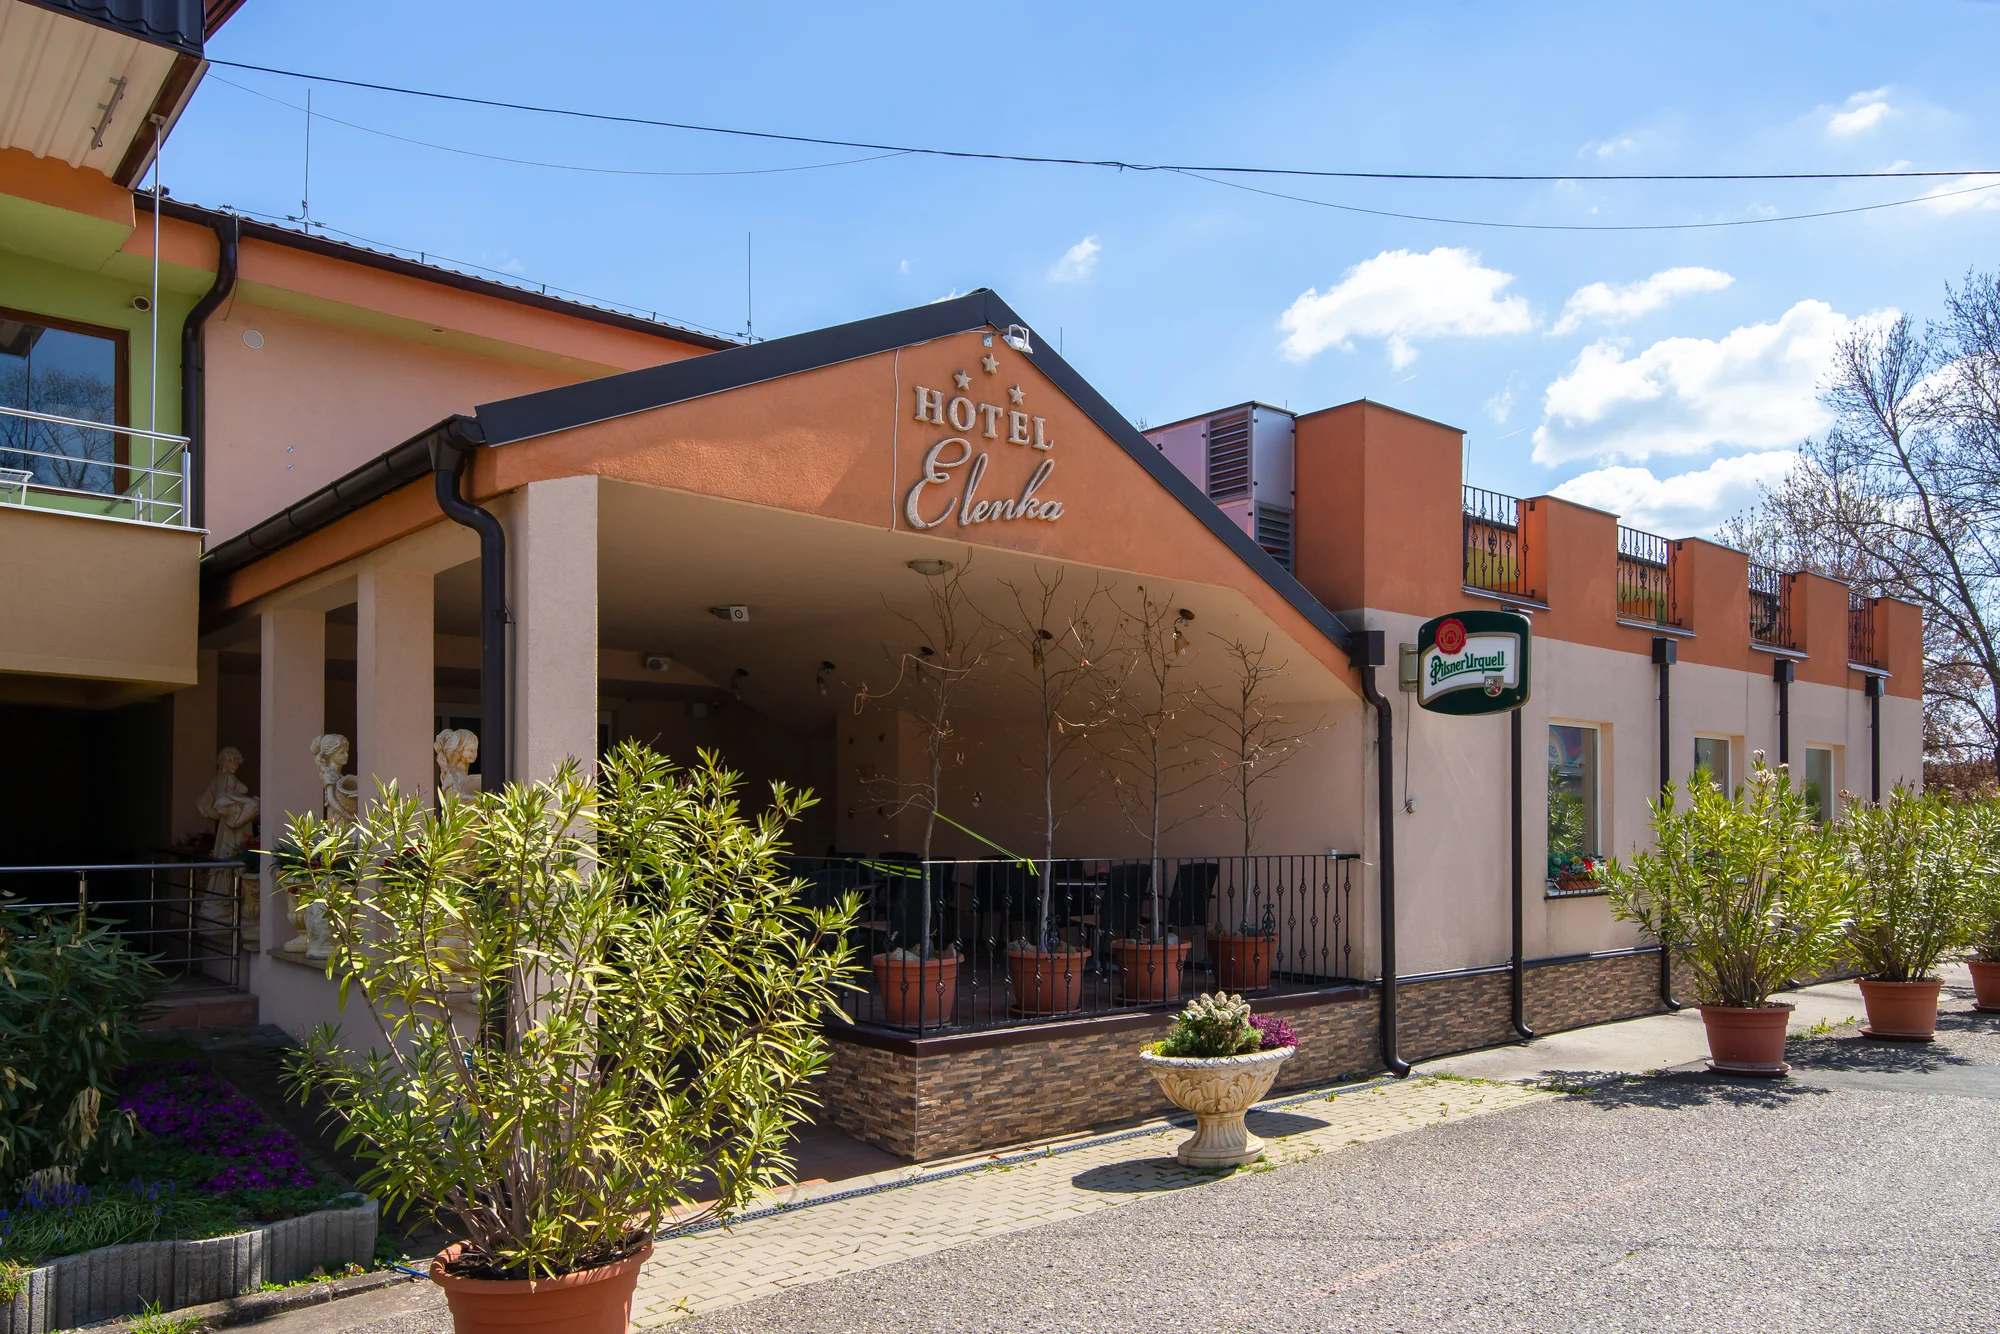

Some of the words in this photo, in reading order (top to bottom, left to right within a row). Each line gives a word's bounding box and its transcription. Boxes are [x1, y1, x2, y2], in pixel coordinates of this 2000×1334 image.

[914, 386, 1054, 450] HOTEL
[906, 437, 1065, 529] Elenka
[1430, 655, 1465, 686] Pilsner
[1464, 651, 1504, 674] Urquell
